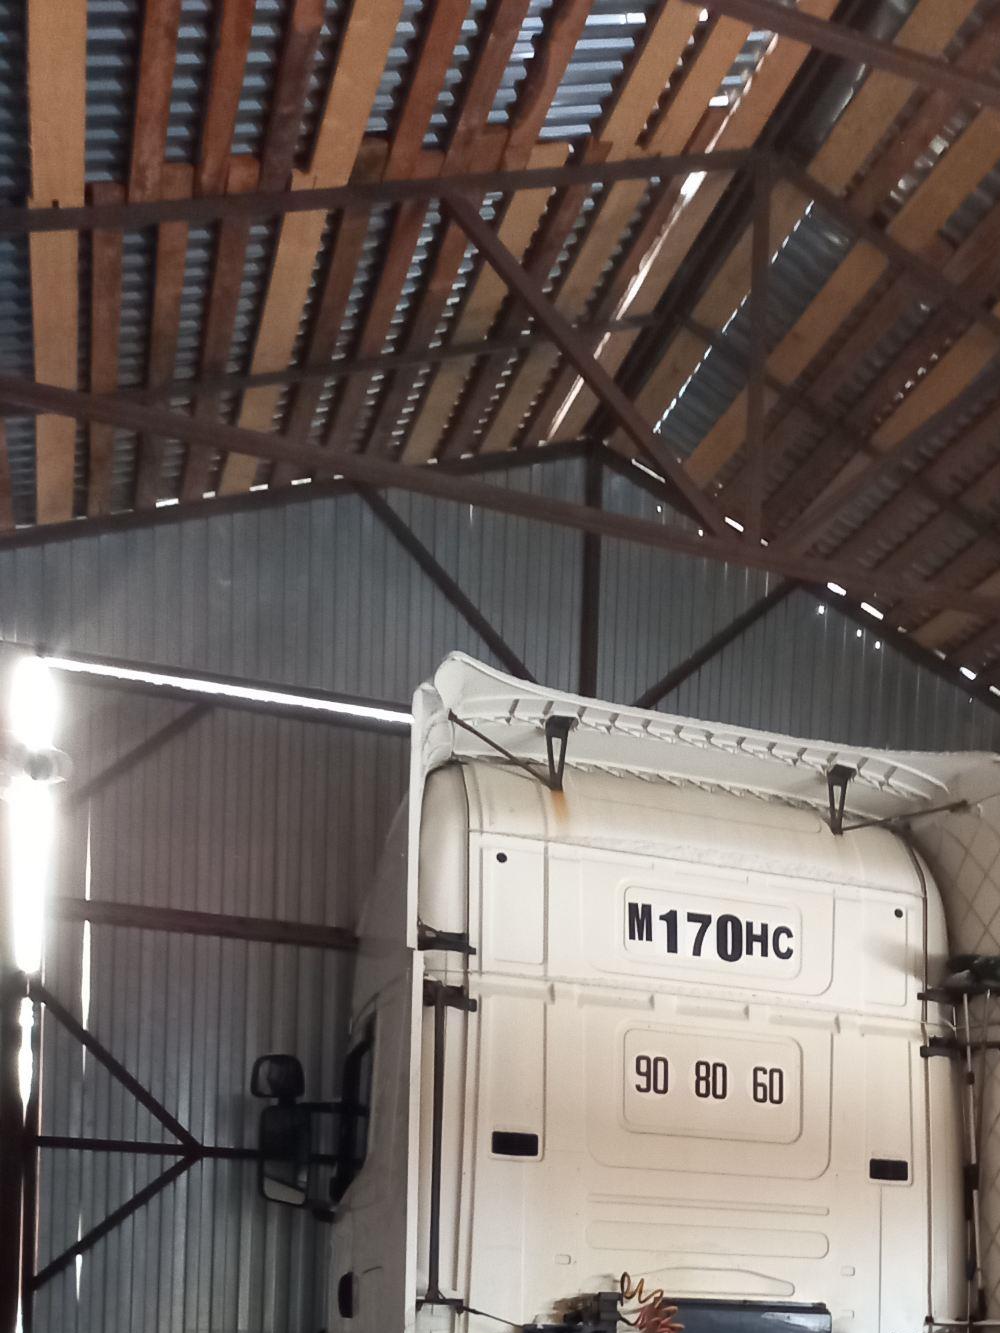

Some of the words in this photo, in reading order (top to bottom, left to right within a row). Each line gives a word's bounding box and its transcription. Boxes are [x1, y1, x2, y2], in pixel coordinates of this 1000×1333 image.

[628, 902, 794, 962] М170НС
[635, 1055, 669, 1095] 90
[694, 1060, 728, 1100] 80
[752, 1066, 784, 1105] 60
